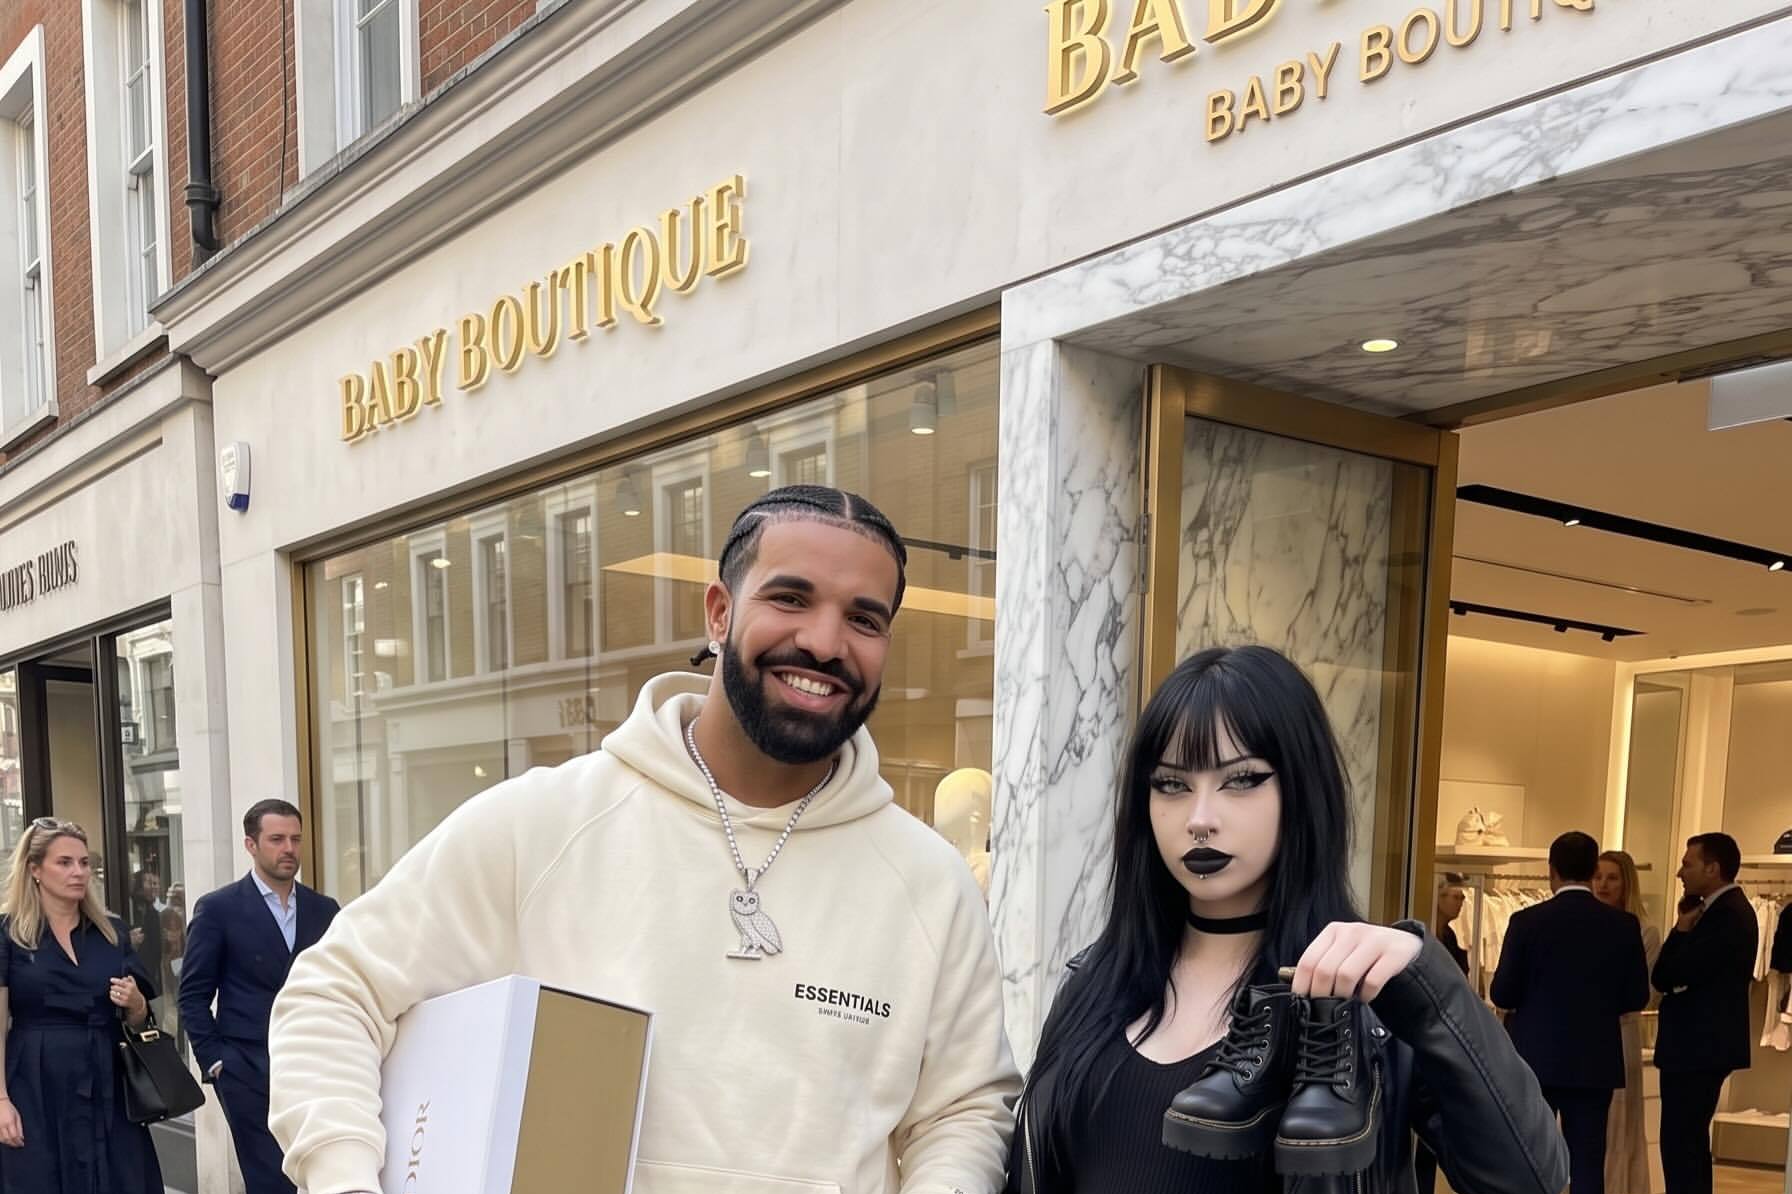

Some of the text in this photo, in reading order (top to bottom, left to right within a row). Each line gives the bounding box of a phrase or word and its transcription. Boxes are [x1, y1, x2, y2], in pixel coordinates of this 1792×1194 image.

[1208, 41, 1341, 143] BABY
[339, 174, 748, 442] BABY BOUTIQUE
[795, 983, 891, 1018] ESSENTIALS
